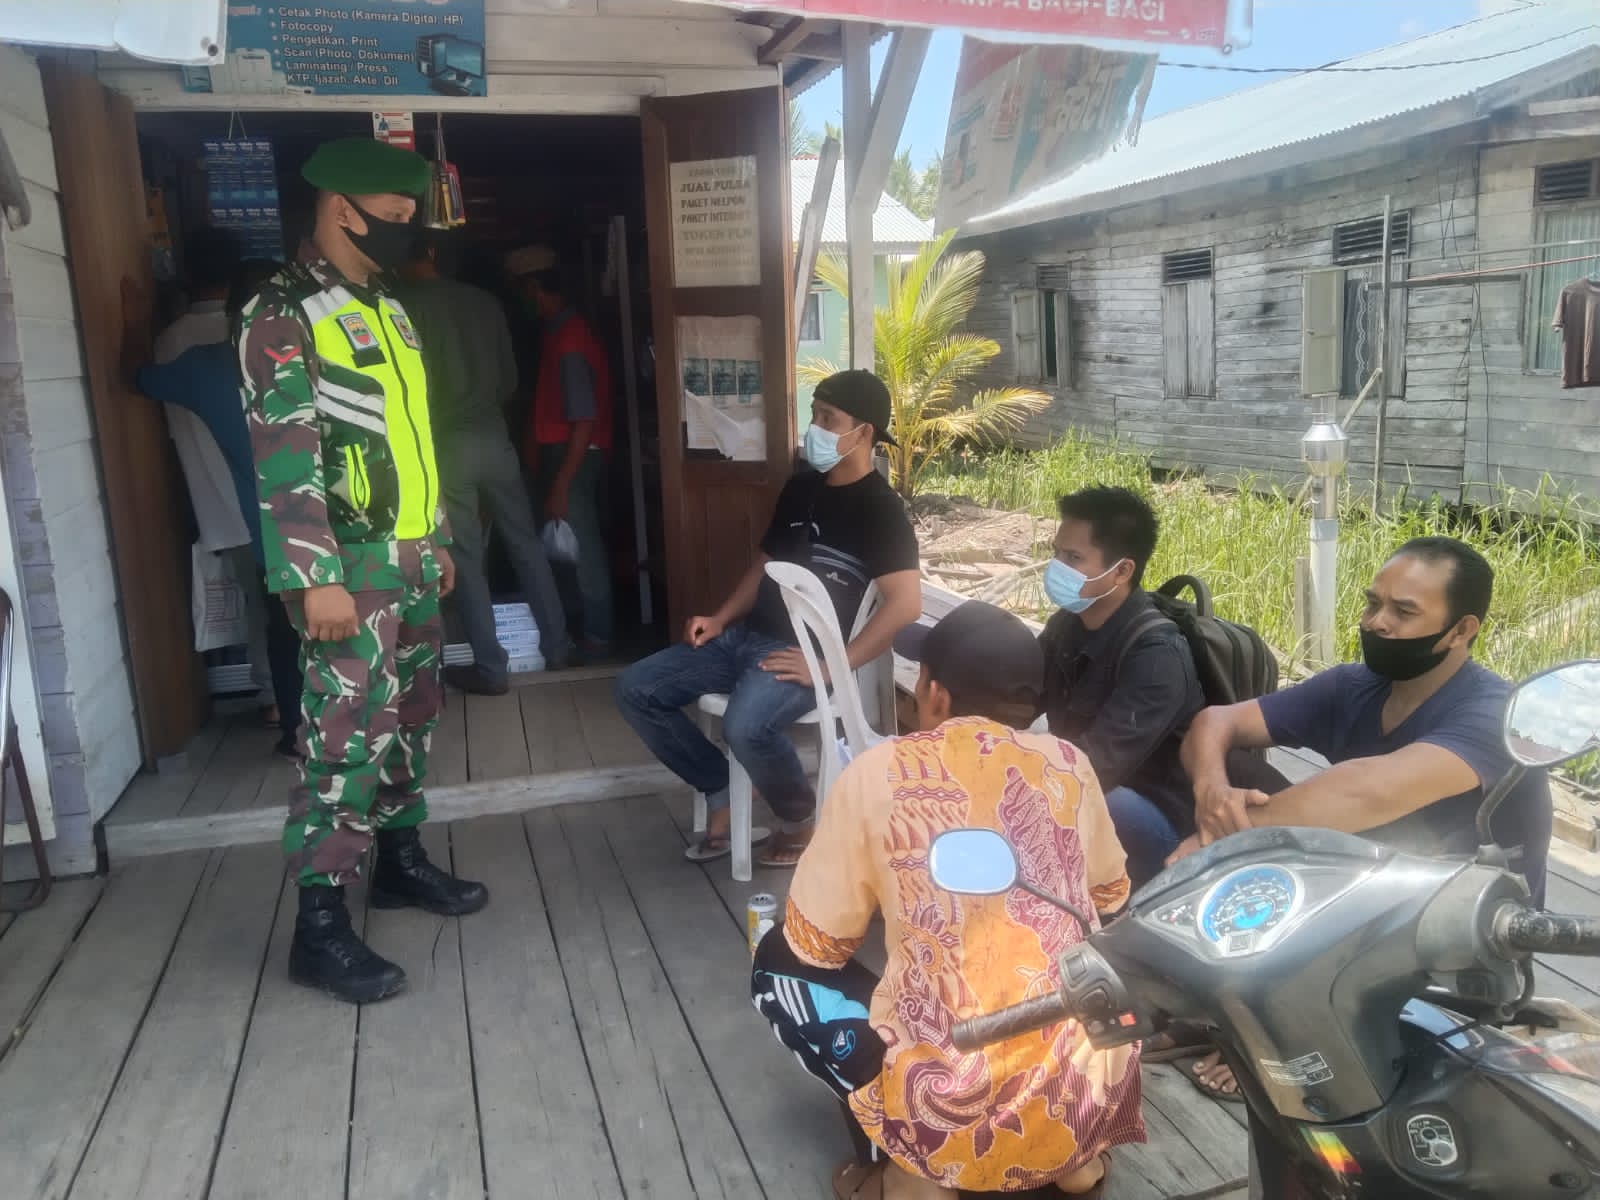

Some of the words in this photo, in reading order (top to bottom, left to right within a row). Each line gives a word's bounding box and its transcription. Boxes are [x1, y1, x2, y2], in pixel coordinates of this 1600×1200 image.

[279, 7, 311, 17] Cetak
[315, 8, 349, 19] Photo
[351, 9, 399, 22] (Kamera
[280, 20, 334, 33] Fotocopy
[351, 36, 378, 47] Print
[284, 47, 312, 57] Scan
[358, 50, 415, 63] Dokumen)
[286, 61, 348, 73] Laminating
[357, 62, 388, 73] Press
[680, 182, 712, 193] JUAL
